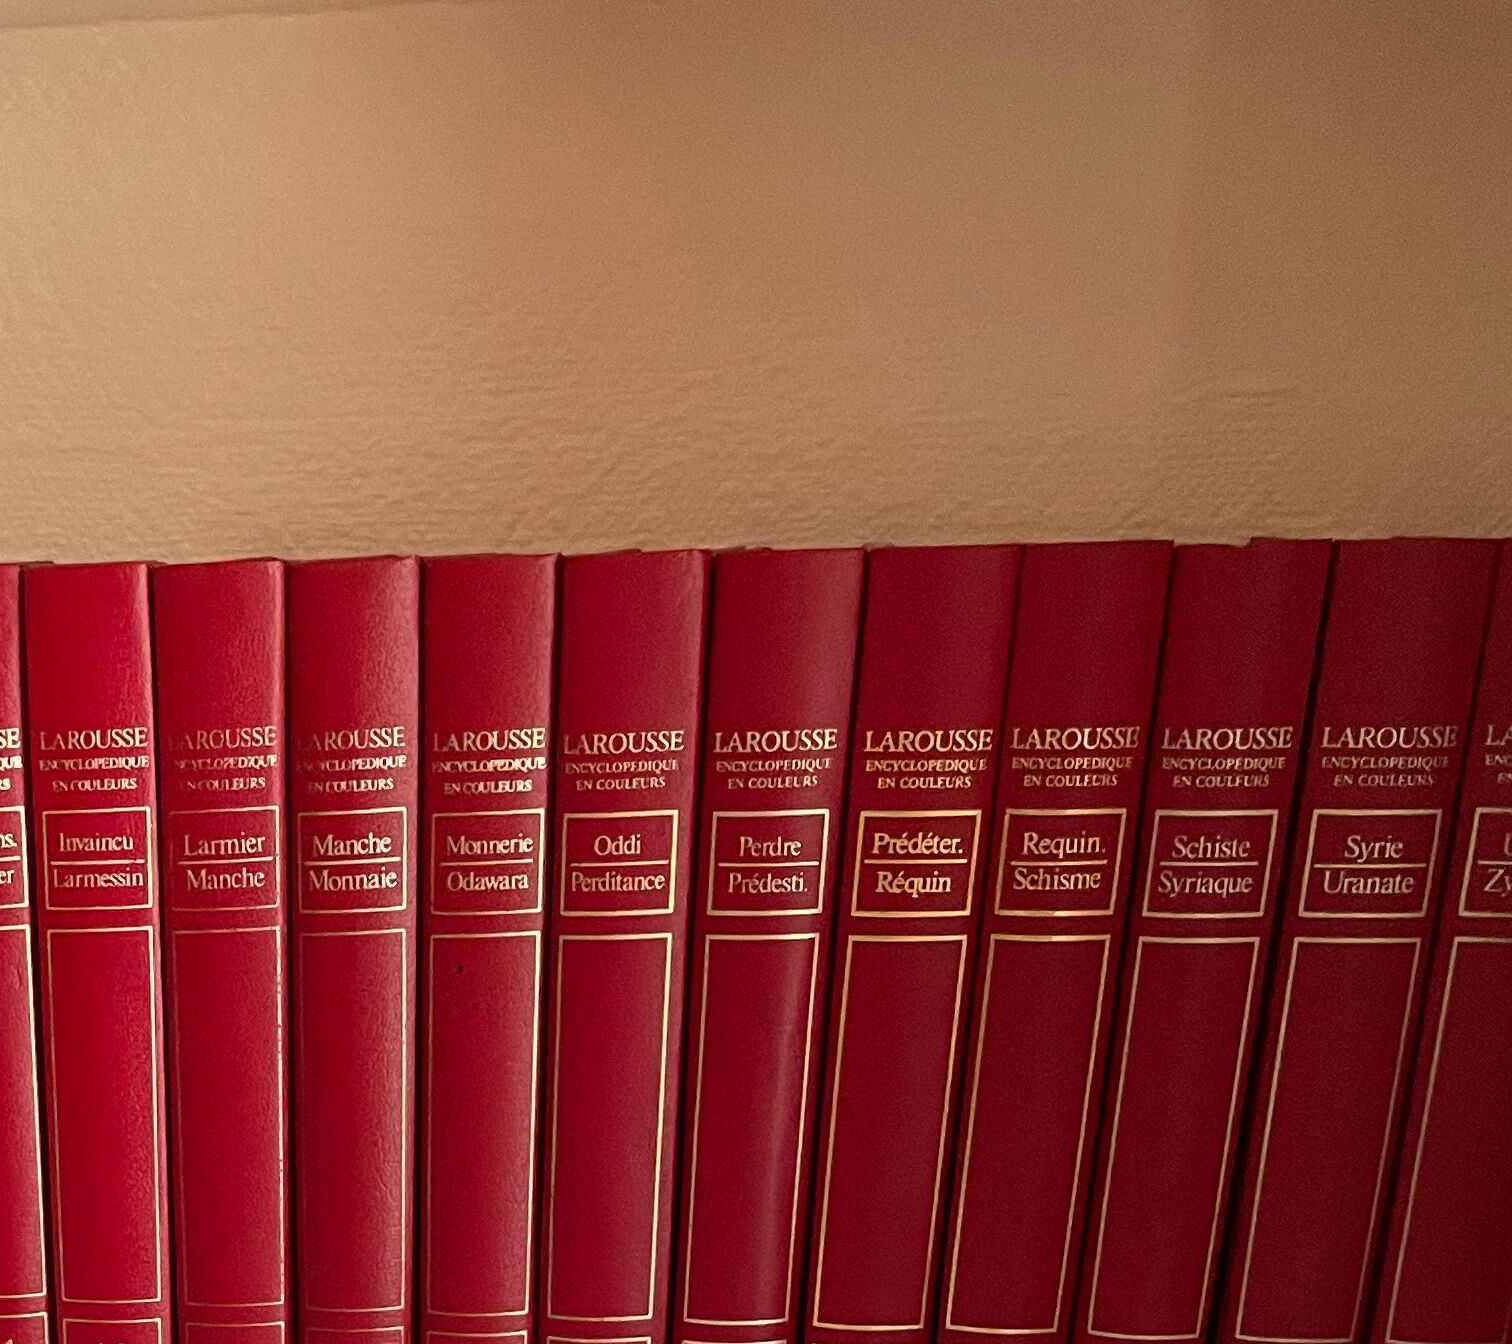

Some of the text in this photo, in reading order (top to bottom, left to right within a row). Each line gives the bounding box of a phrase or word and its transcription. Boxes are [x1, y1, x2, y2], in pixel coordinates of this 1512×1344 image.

[40, 728, 148, 750] LAROUSSE
[300, 726, 406, 750] AROUSSE
[433, 728, 546, 752] LAROUSSE
[563, 730, 685, 754] LAROUSSE
[713, 729, 838, 753] LAROUSSE
[864, 729, 994, 752] LAROUSSE
[1009, 727, 1140, 750] LAROUSSE
[1161, 726, 1294, 750] LAROUSSE
[1320, 725, 1459, 749] LAROUSSE
[174, 755, 278, 770] CYCLOPEDIQUE
[71, 778, 138, 790] COULEURS
[197, 777, 266, 790] COULEURS
[325, 777, 394, 791] COULEURS
[463, 779, 533, 793] COULEURS
[596, 777, 666, 790] COULEURS
[748, 775, 818, 789] COULEURS
[899, 776, 972, 789] COULEURS
[1045, 774, 1118, 787] COULEURS
[1195, 774, 1270, 788] COULEURS
[1357, 774, 1435, 787] COULEURS
[59, 832, 134, 851] Invaincu
[183, 832, 265, 856] Larmier
[313, 831, 392, 856] Manche
[446, 833, 534, 855] Monnerie
[594, 834, 641, 856] Oddi
[739, 836, 802, 857] Perdre
[872, 832, 964, 855] Prédéter.
[1171, 835, 1252, 858] Schiste
[1343, 835, 1404, 863] Syrie
[53, 867, 144, 888] Larmessin
[186, 867, 265, 889] Manche
[309, 867, 398, 891] Monnaie
[447, 871, 529, 891] Odawara
[571, 872, 666, 892] Perditance
[728, 871, 809, 893] Prédesti.
[875, 871, 952, 898] Réquin
[1013, 867, 1101, 890] Schisme
[1158, 870, 1254, 898] Syriaque
[1322, 870, 1416, 894] Uranate
